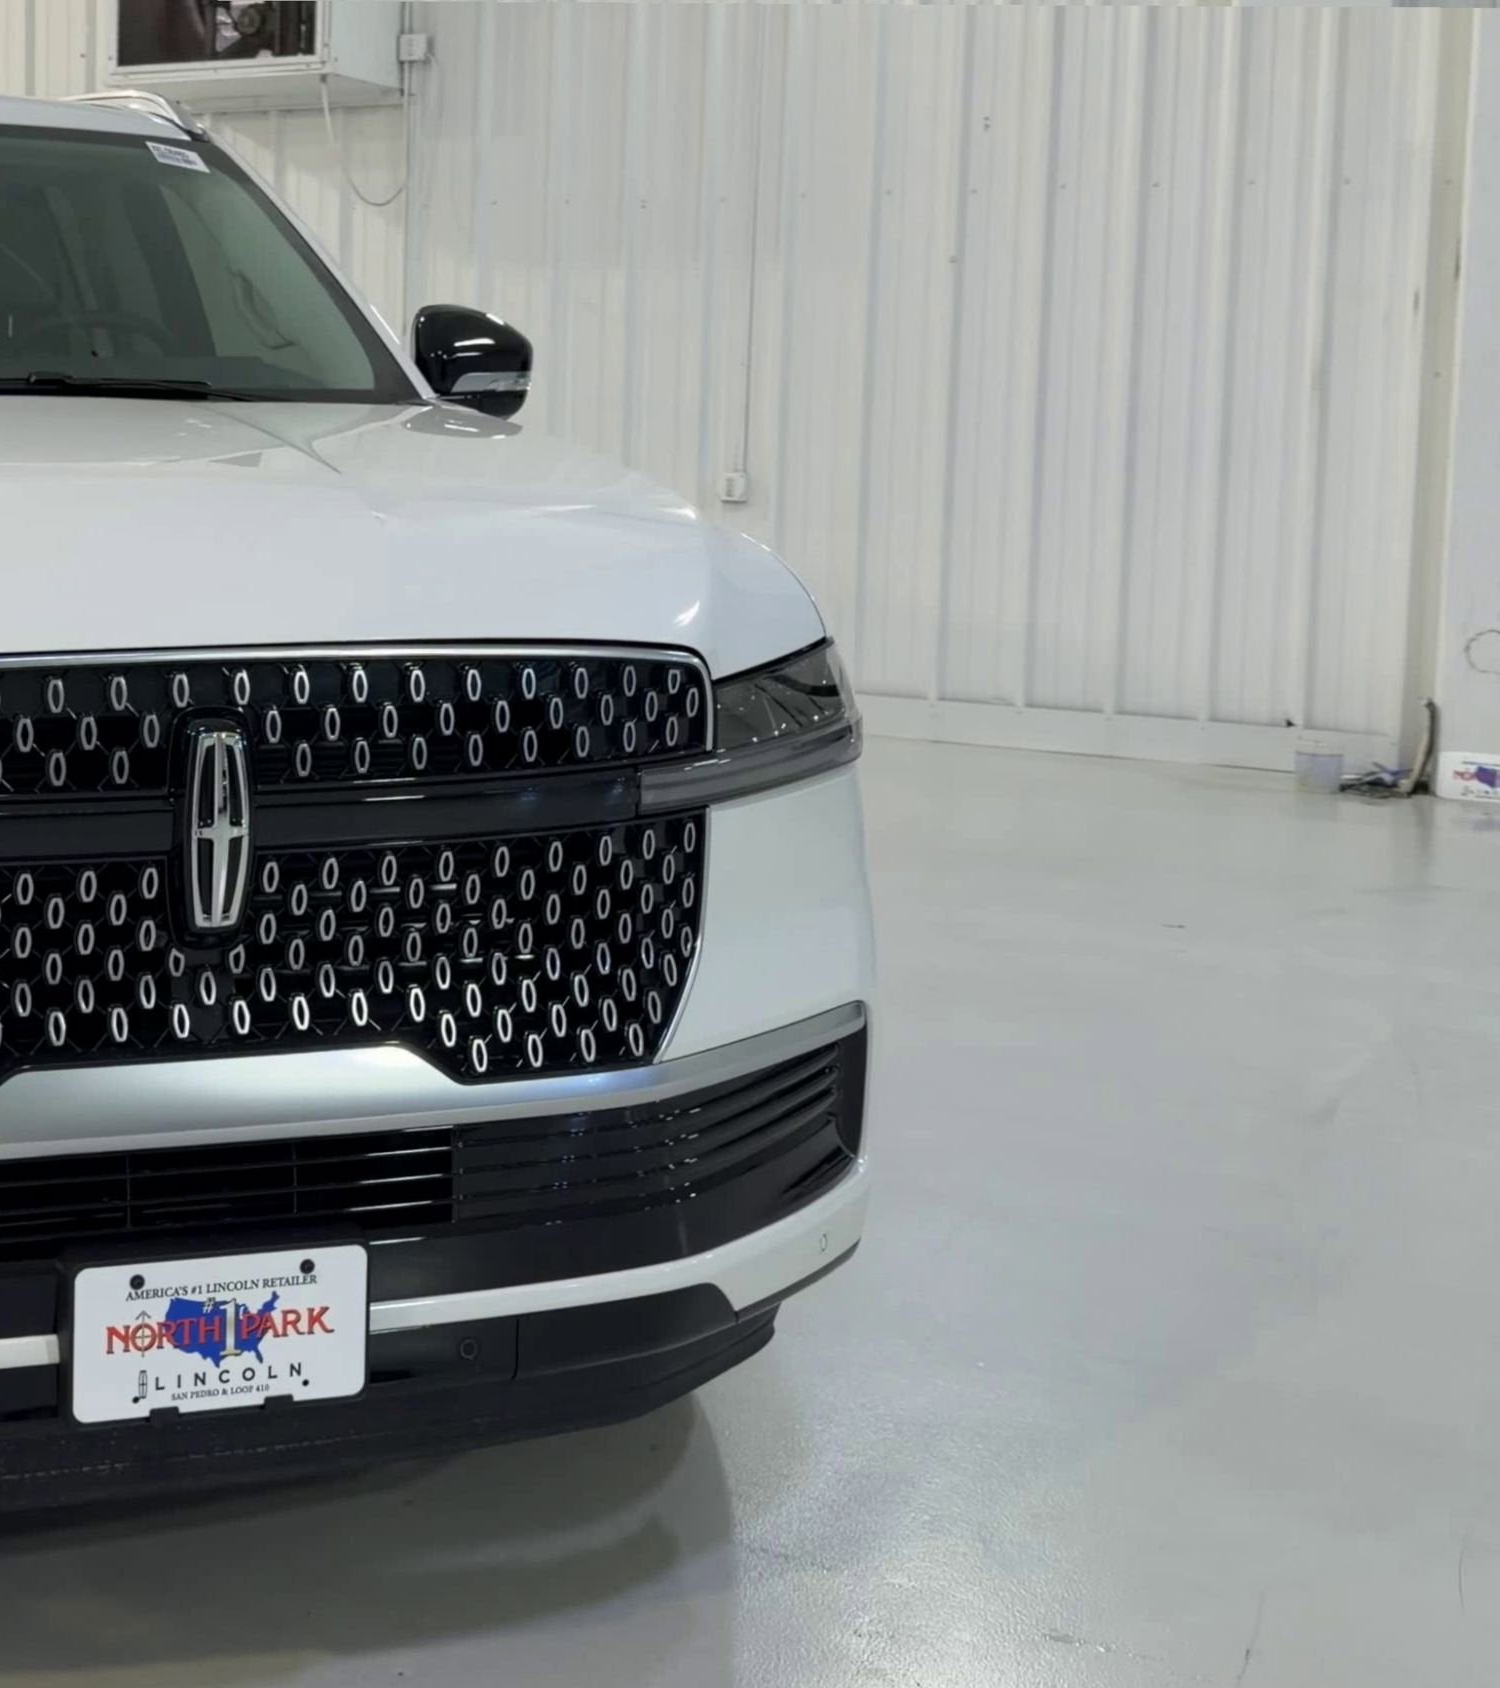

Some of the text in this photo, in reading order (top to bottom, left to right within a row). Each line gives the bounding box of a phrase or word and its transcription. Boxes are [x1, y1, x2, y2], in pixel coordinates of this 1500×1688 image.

[125, 1274, 318, 1301] AMERICA'S #1 LINCOLN RETAILER
[106, 1306, 335, 1354] NORTH PARK
[155, 1363, 302, 1391] LINCOLN
[171, 1383, 270, 1401] SAN PEDRO & LOOP 410
